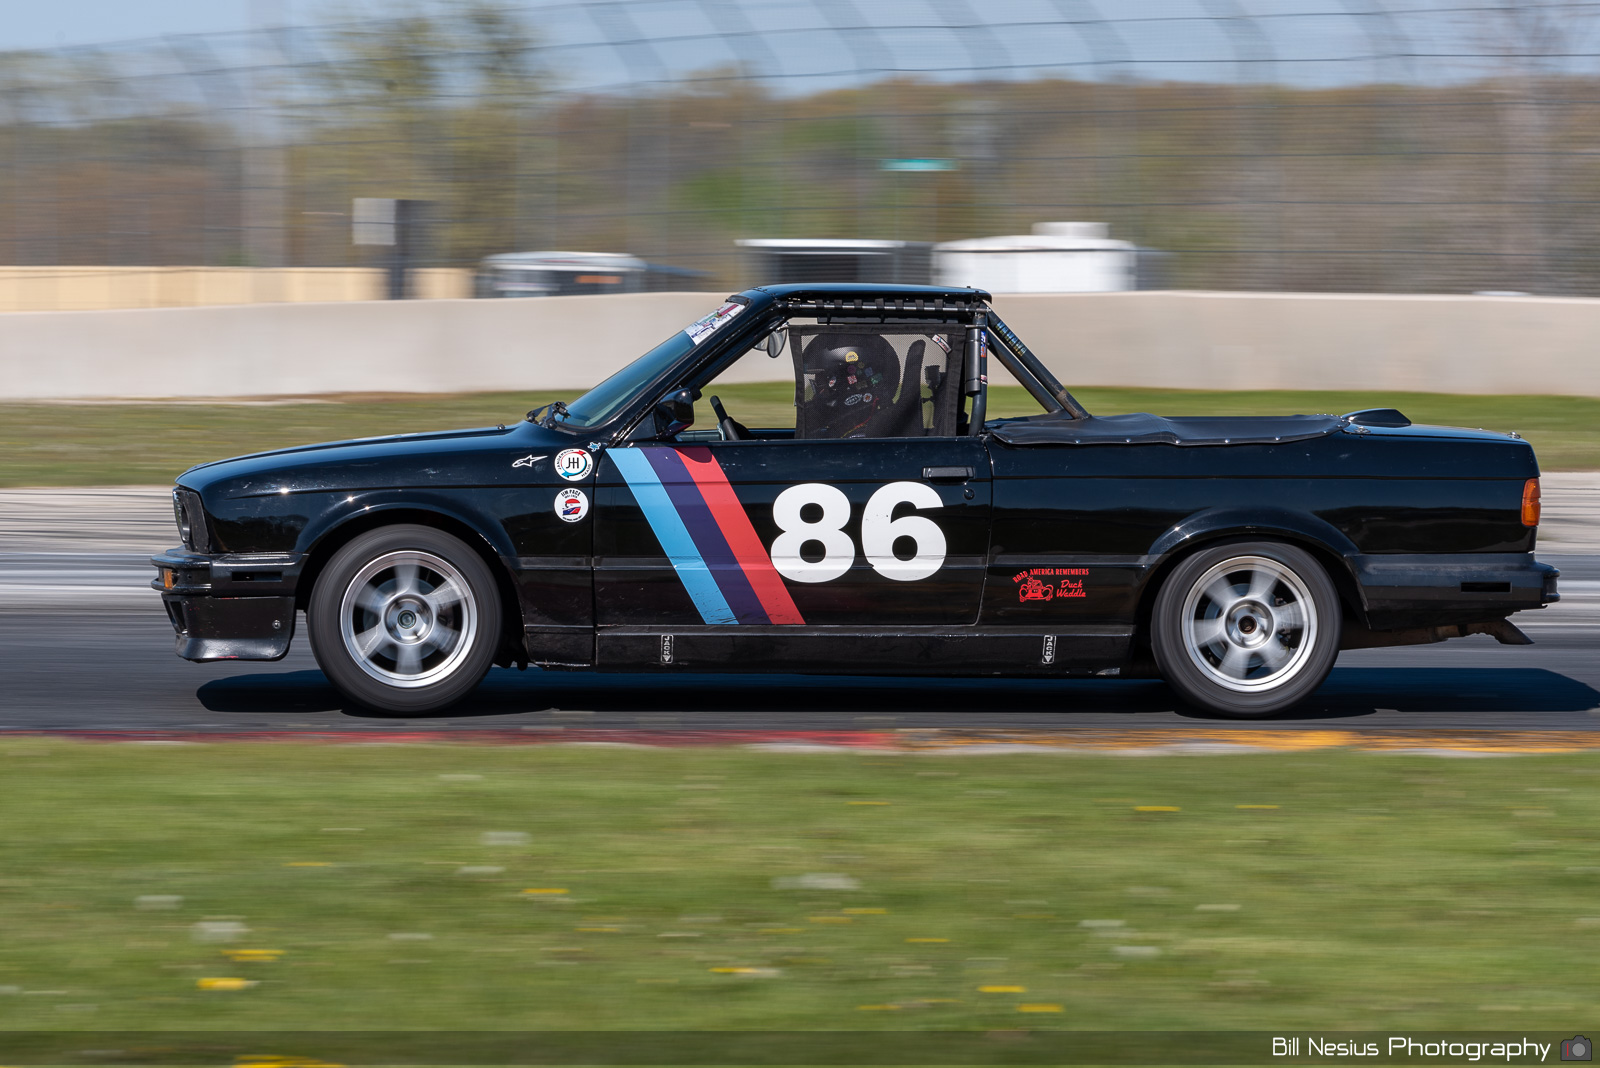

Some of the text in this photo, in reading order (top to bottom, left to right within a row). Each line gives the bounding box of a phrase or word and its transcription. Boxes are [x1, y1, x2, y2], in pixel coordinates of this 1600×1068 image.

[771, 481, 947, 583] 86
[1012, 568, 1089, 583] ROAD AMERICA REMEMBERS
[1061, 579, 1083, 588] Duck
[1056, 589, 1086, 598] Waddle
